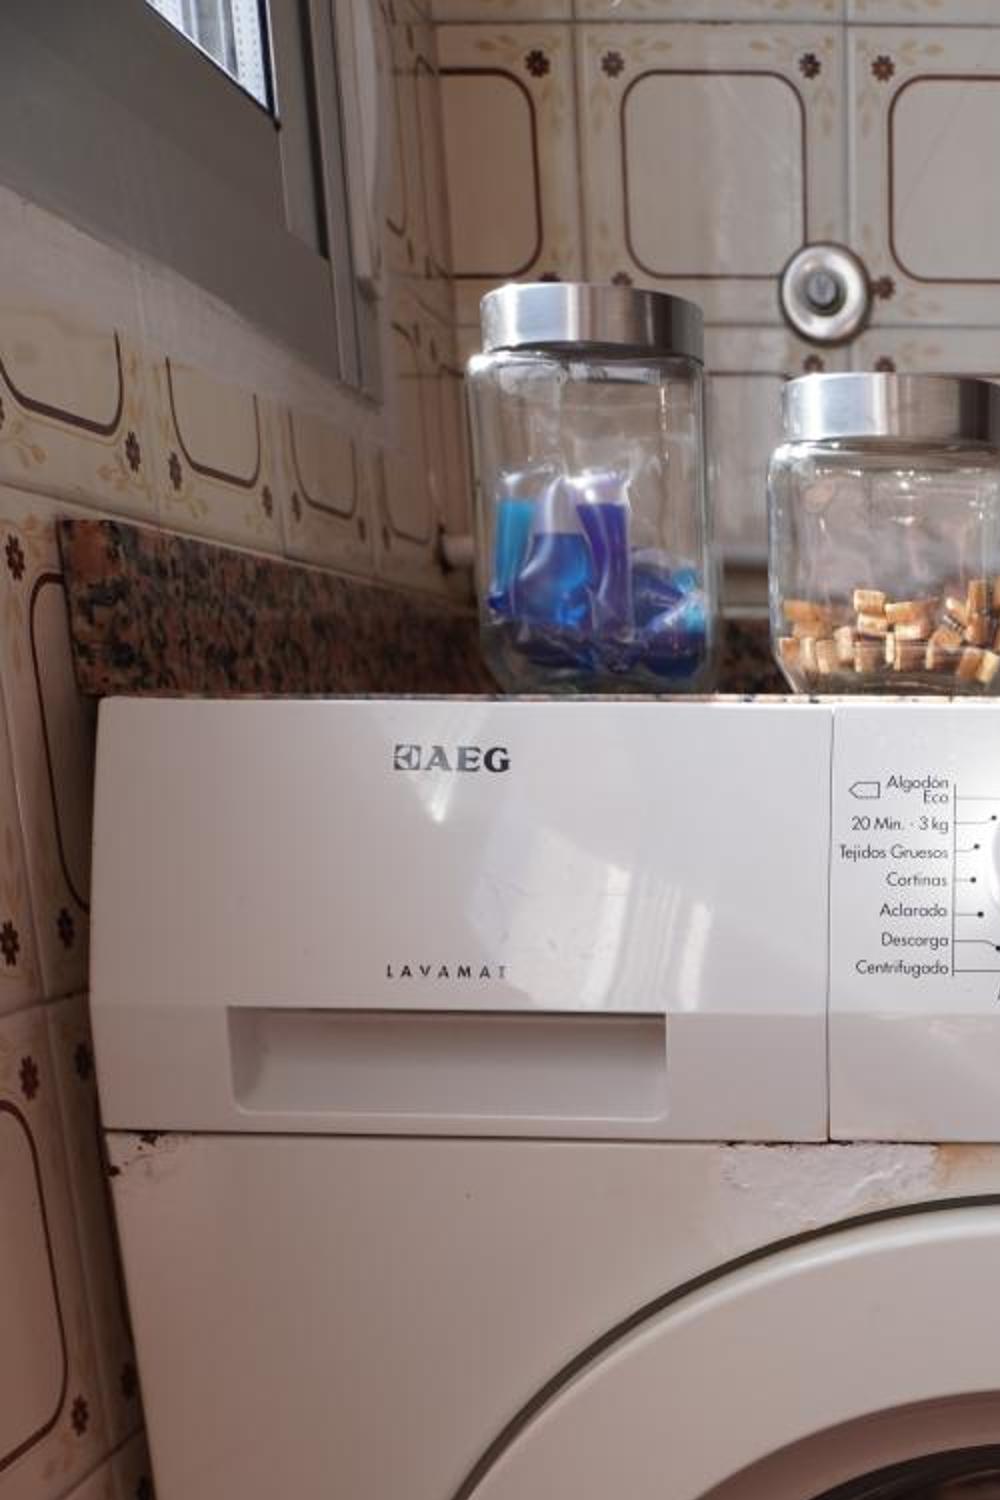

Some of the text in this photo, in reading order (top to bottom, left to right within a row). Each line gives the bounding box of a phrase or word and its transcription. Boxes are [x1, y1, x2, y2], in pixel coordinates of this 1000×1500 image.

[424, 746, 510, 773] AEG
[923, 790, 949, 804] Eco
[852, 816, 871, 831] 20
[919, 815, 929, 831] 3
[931, 816, 949, 835] kg
[840, 843, 948, 864] Tejidos Gruesos
[885, 871, 947, 889] Cortinas
[880, 902, 948, 917] Aclarado
[882, 931, 949, 953] Descarga
[387, 965, 508, 979] LAVAMAT
[855, 959, 949, 979] Centrifugado
